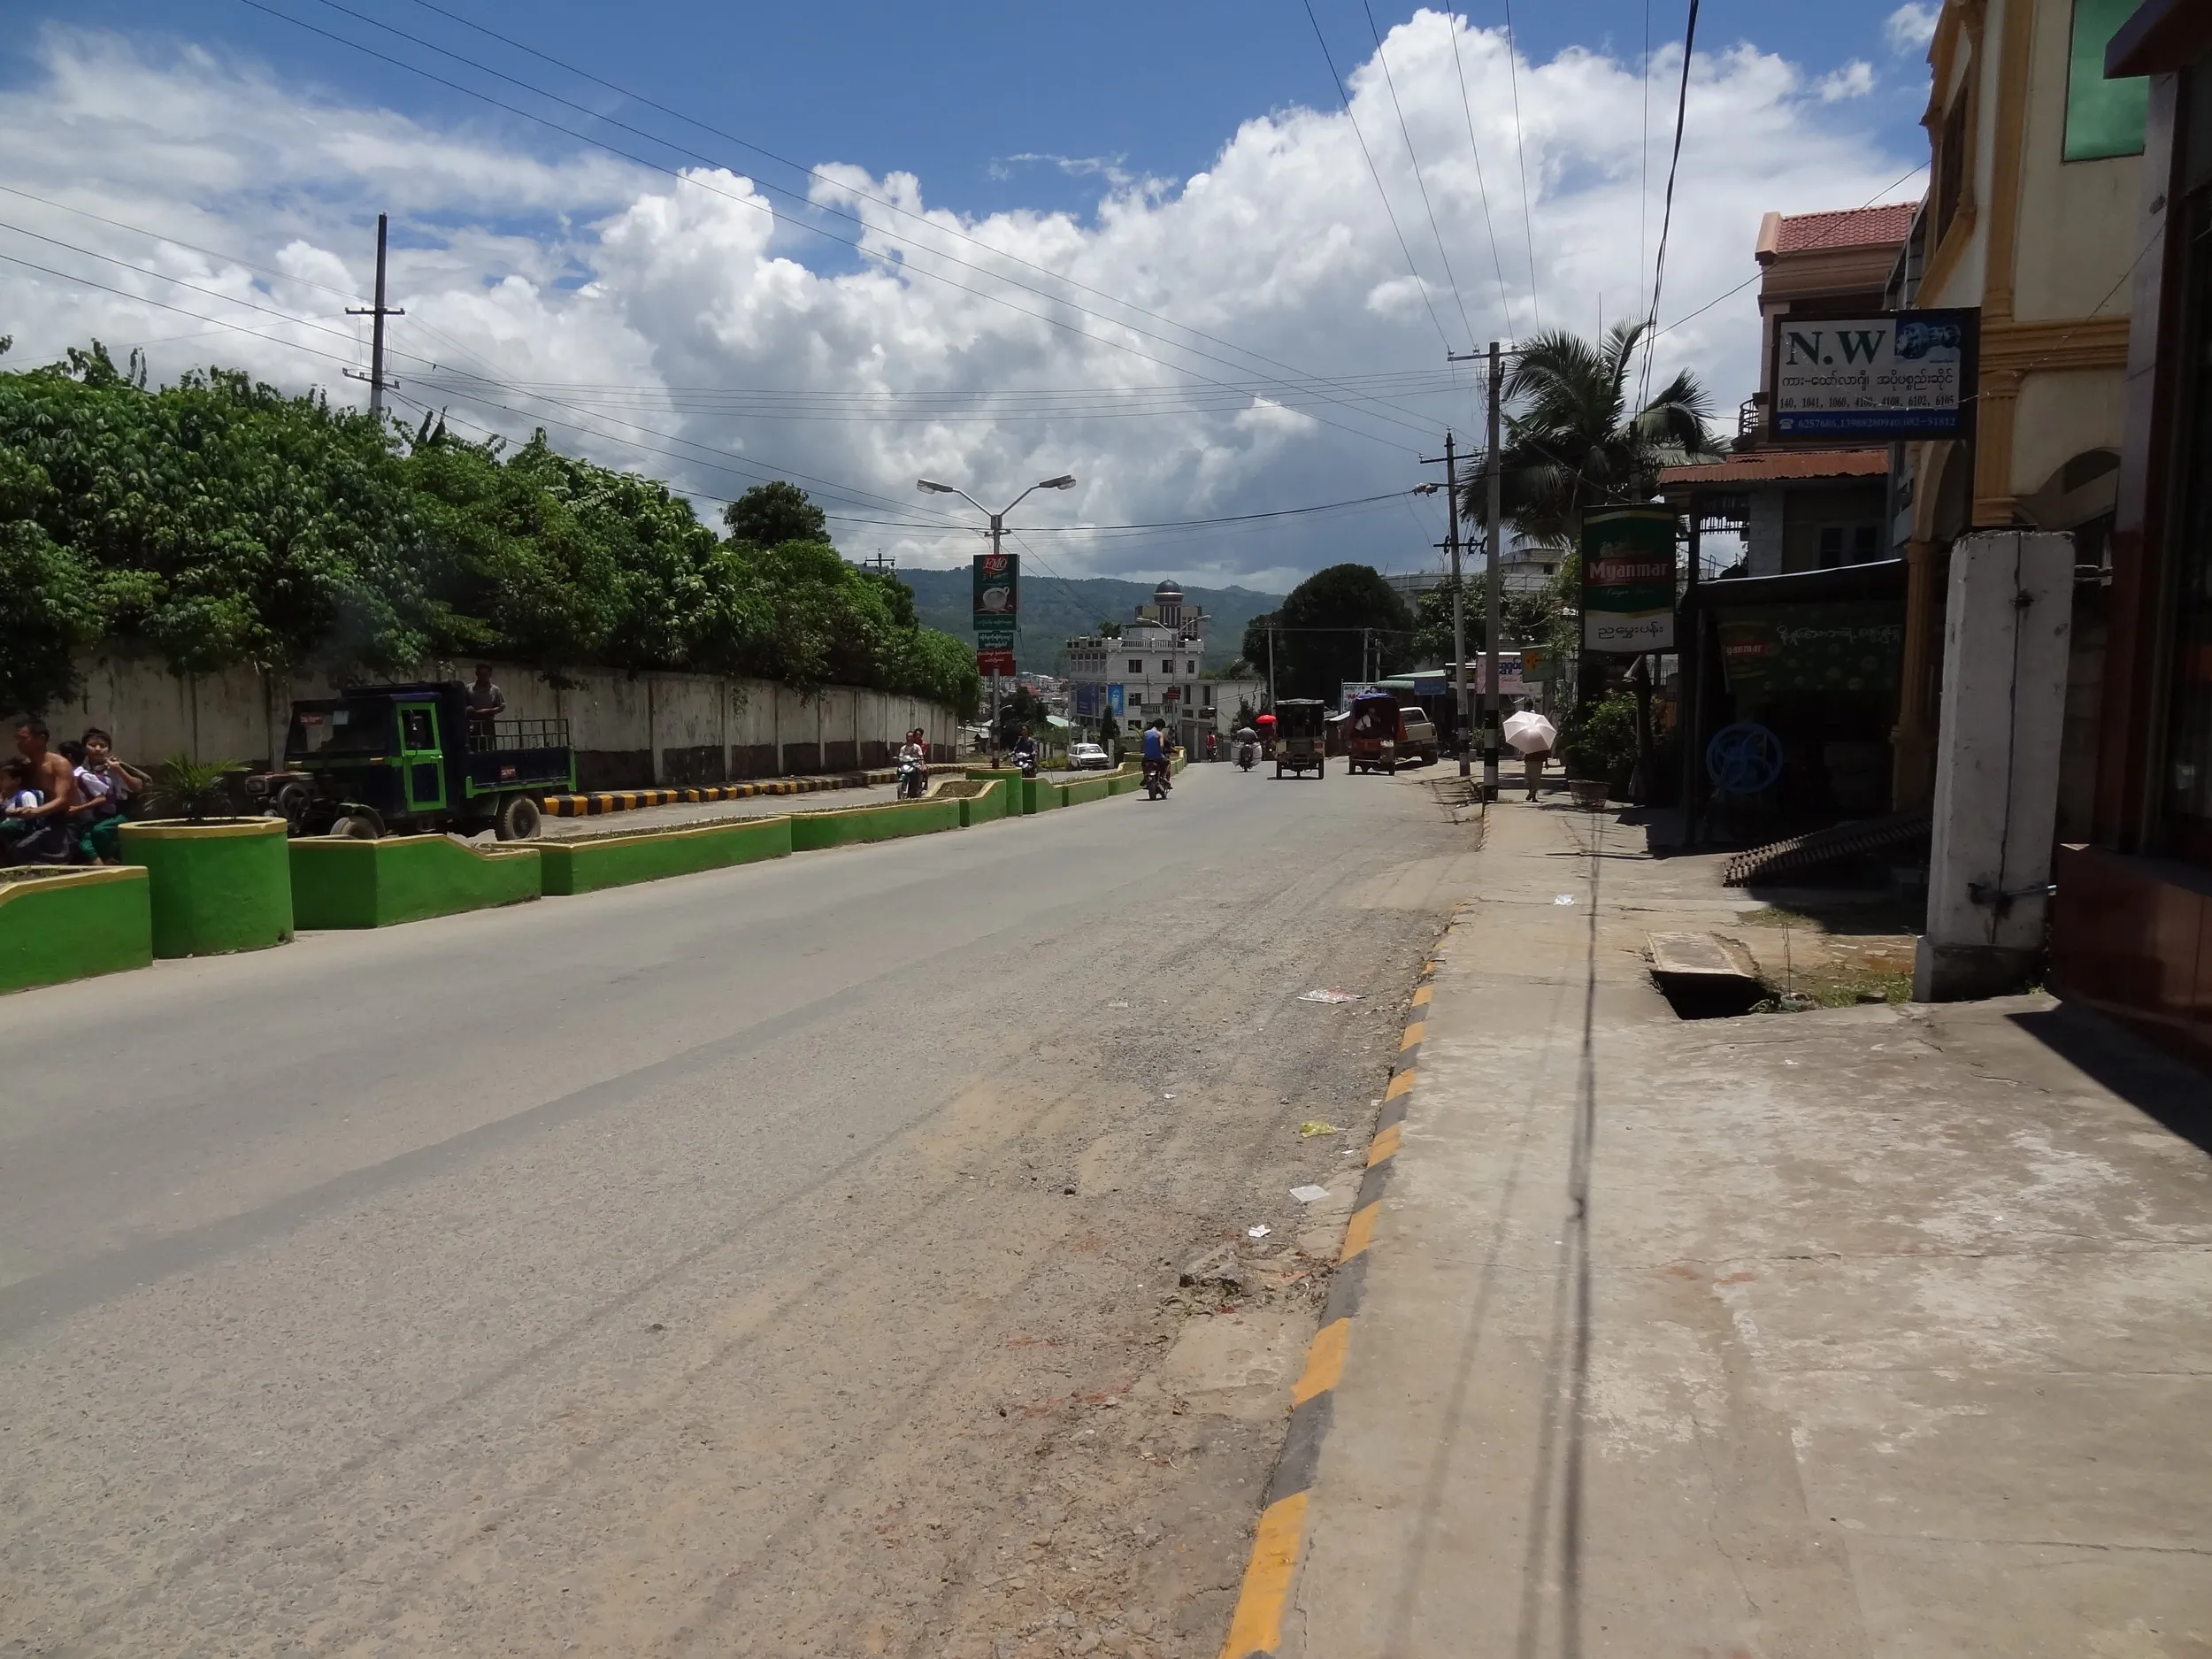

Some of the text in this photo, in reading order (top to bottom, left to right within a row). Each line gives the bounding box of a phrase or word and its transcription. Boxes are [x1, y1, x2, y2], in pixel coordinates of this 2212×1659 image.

[1786, 330, 1886, 365] N.W
[1589, 562, 1669, 581] Myanmar
[1724, 643, 1763, 657] yanmar
